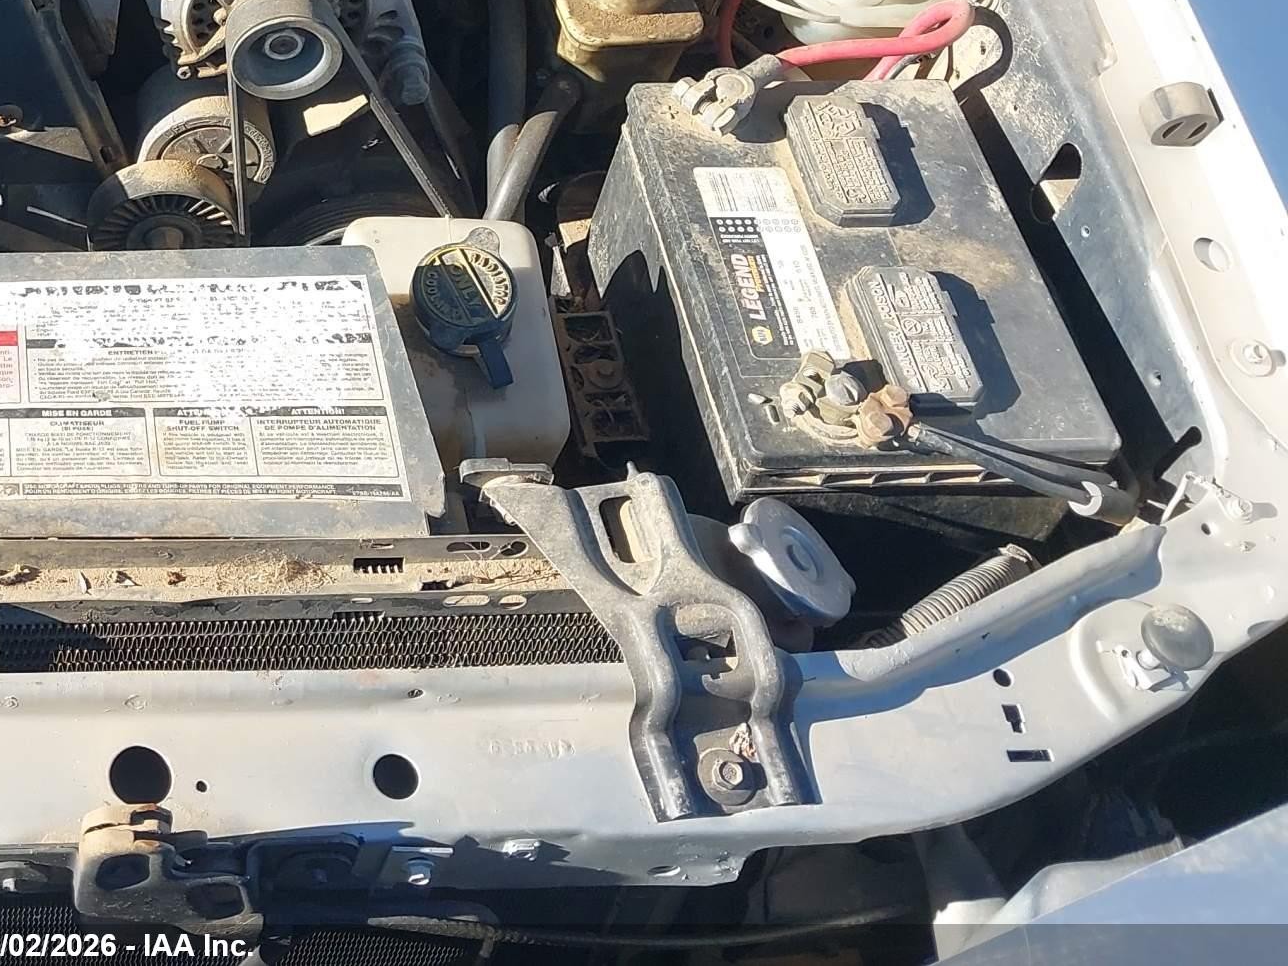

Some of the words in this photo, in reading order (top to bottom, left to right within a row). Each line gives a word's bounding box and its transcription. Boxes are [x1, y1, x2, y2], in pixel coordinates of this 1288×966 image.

[470, 253, 511, 305] RADIATOR
[730, 253, 768, 321] LEGEND
[868, 280, 897, 321] POISON
[889, 331, 918, 380] DANGER
[42, 409, 64, 417] MISE
[66, 409, 79, 417] EN
[80, 409, 113, 417] GARDE
